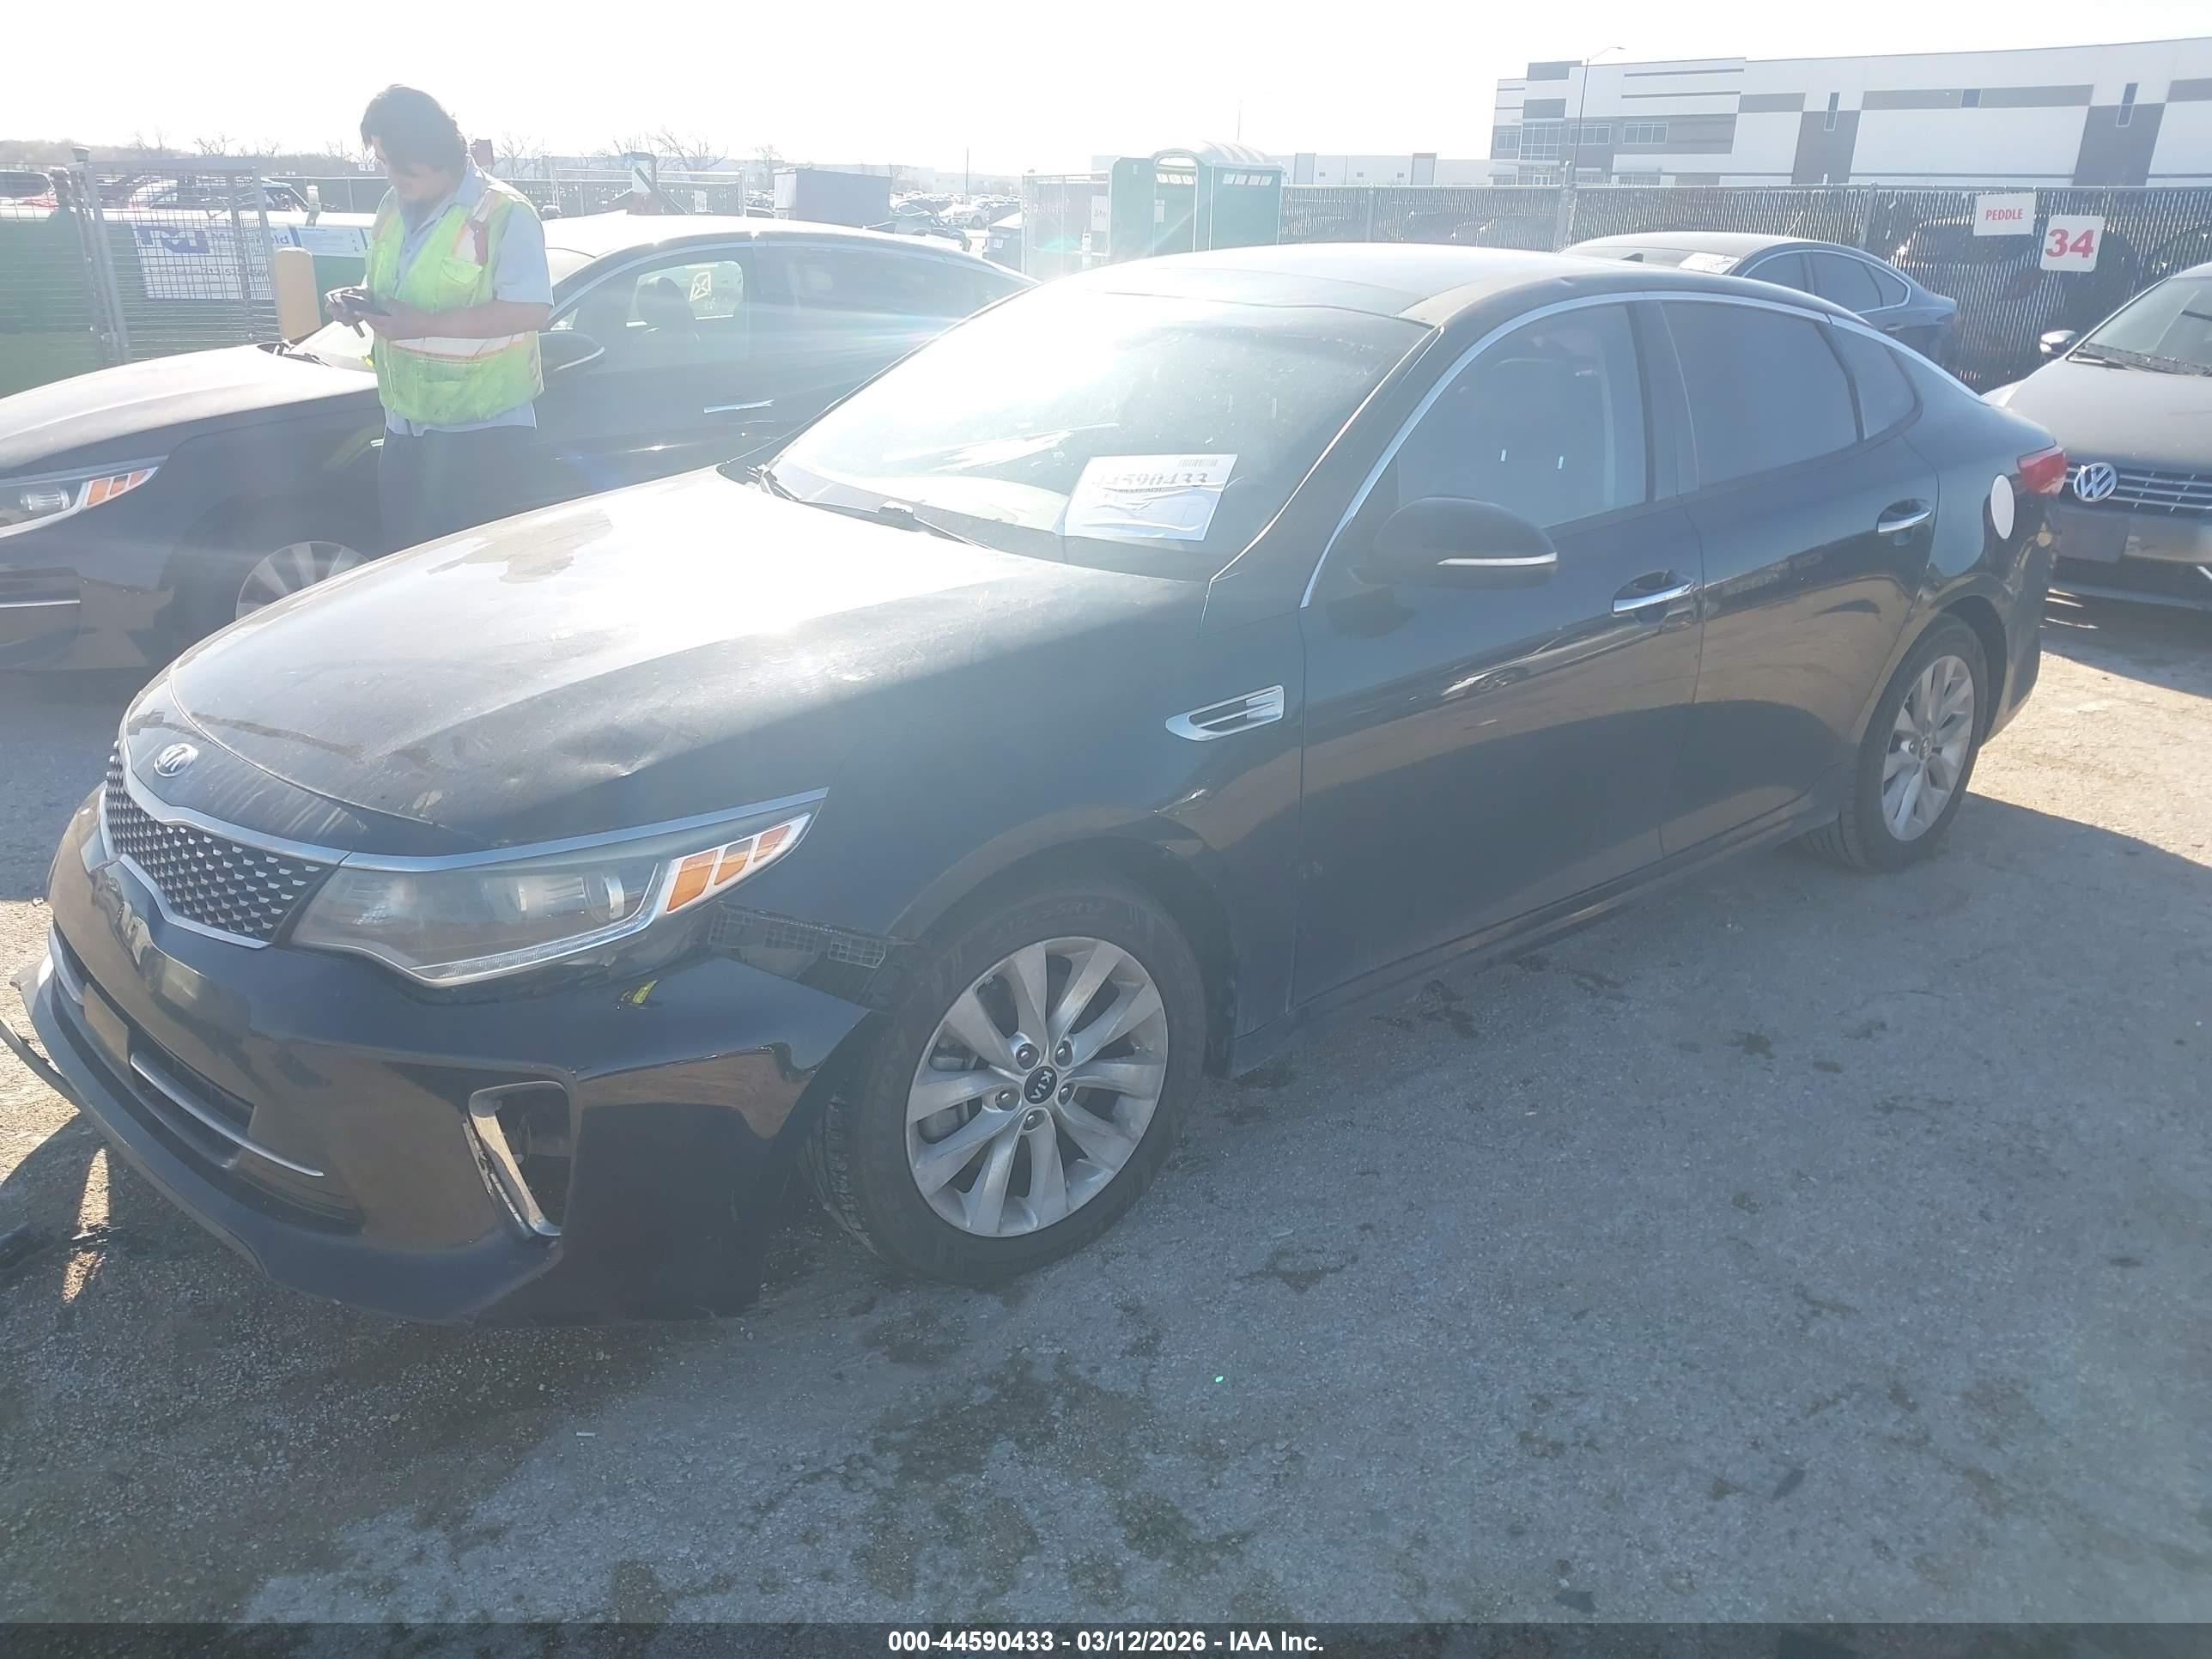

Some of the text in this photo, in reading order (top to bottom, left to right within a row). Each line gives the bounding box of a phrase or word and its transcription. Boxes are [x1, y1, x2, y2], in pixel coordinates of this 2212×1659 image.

[1985, 209, 2023, 220] PEDDLE
[2045, 228, 2095, 258] 34
[1030, 1070, 1053, 1099] KIA
